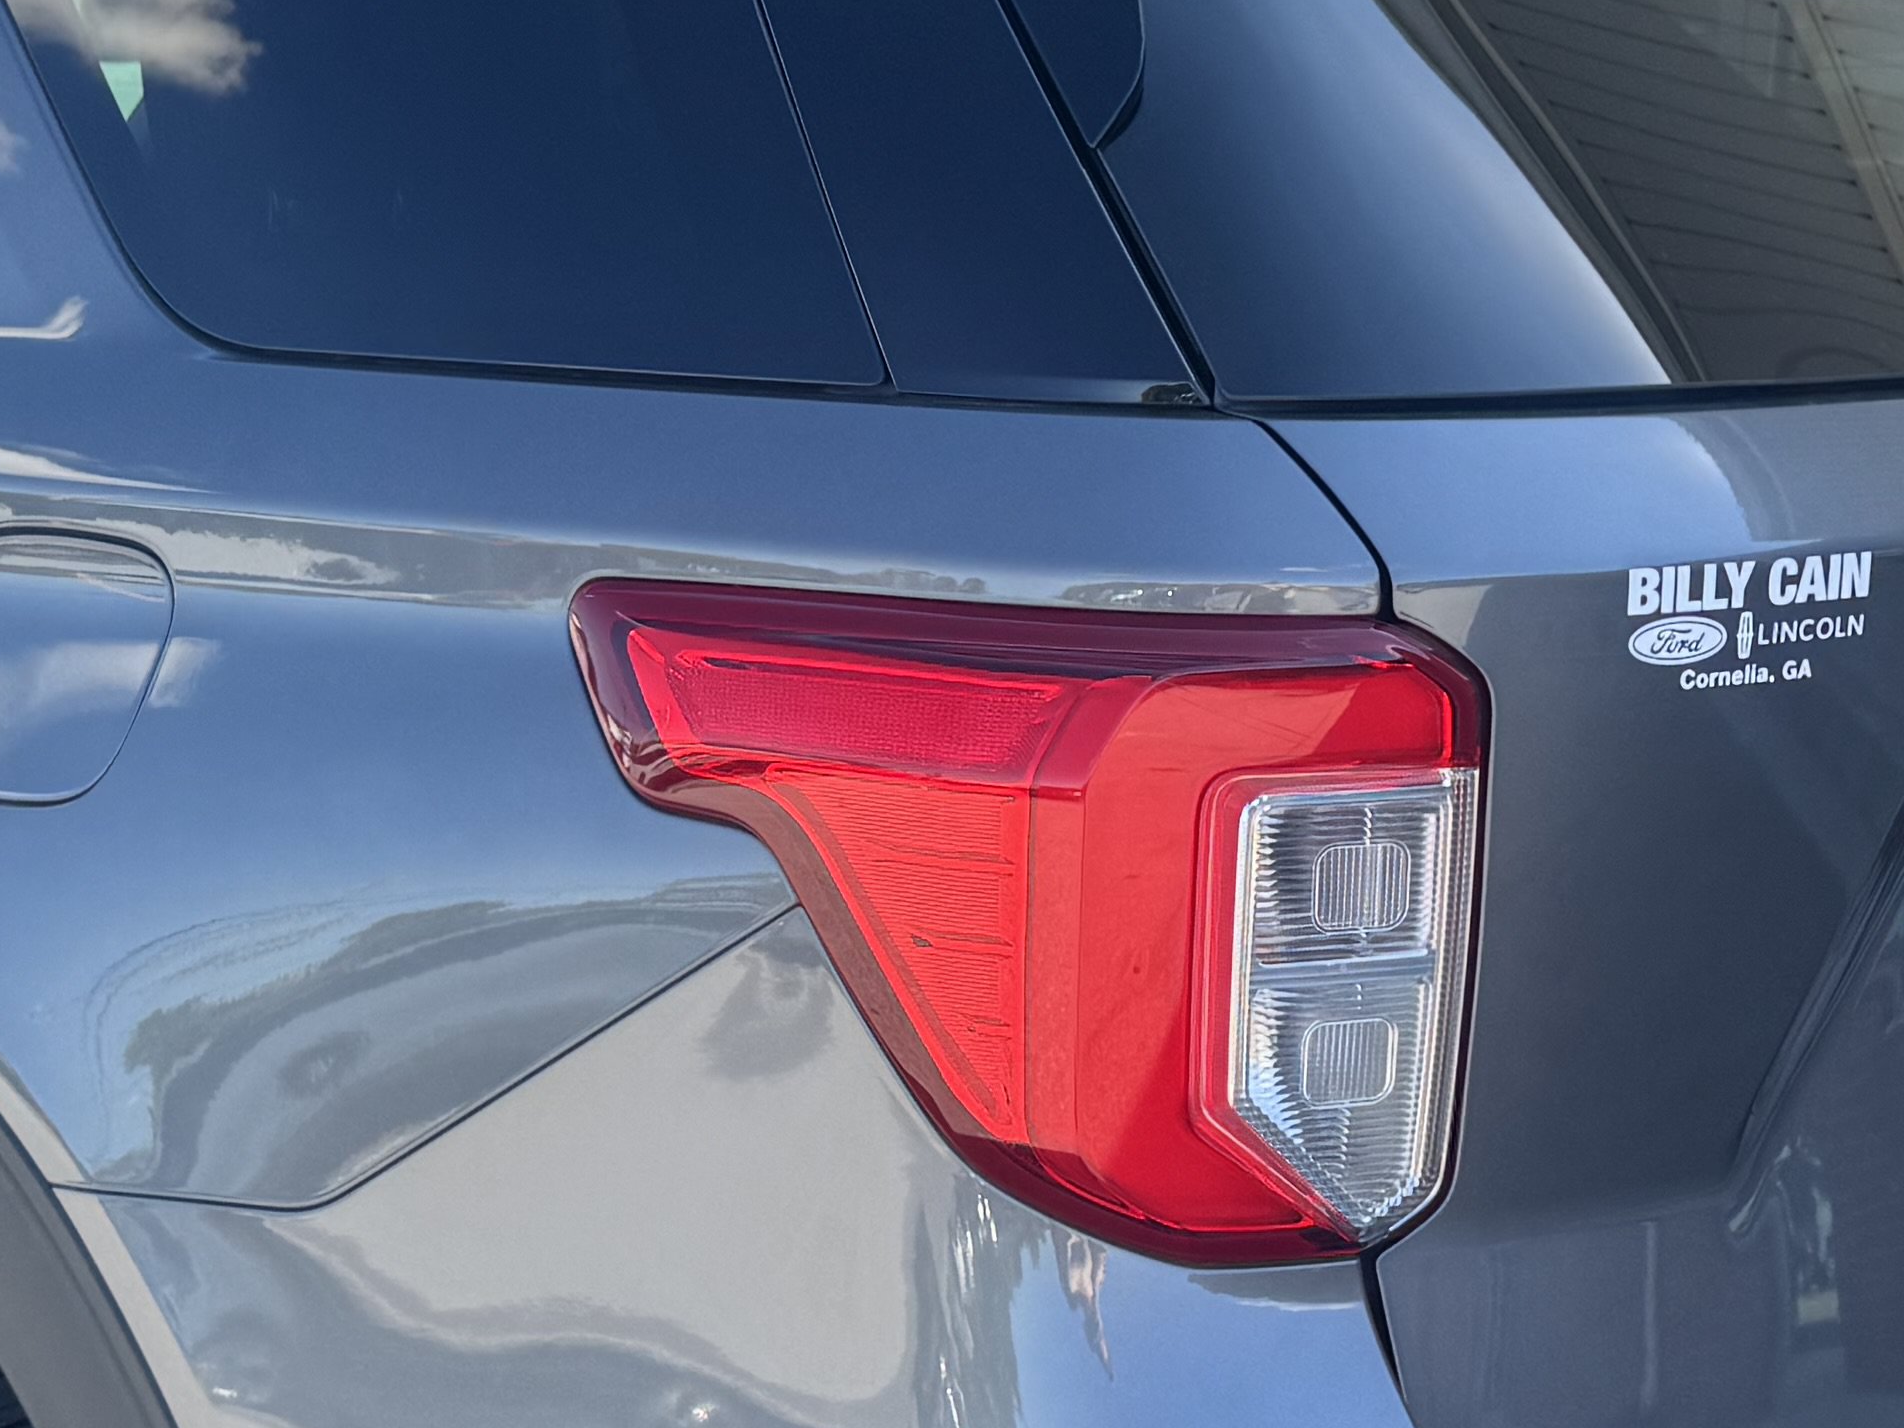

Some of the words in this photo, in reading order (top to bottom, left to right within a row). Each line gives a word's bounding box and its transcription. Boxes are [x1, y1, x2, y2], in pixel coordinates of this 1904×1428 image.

[1627, 561, 1756, 616] BILLY
[1768, 550, 1873, 606] CAIN
[1757, 614, 1865, 645] LINCOLN
[1782, 659, 1813, 681] GA
